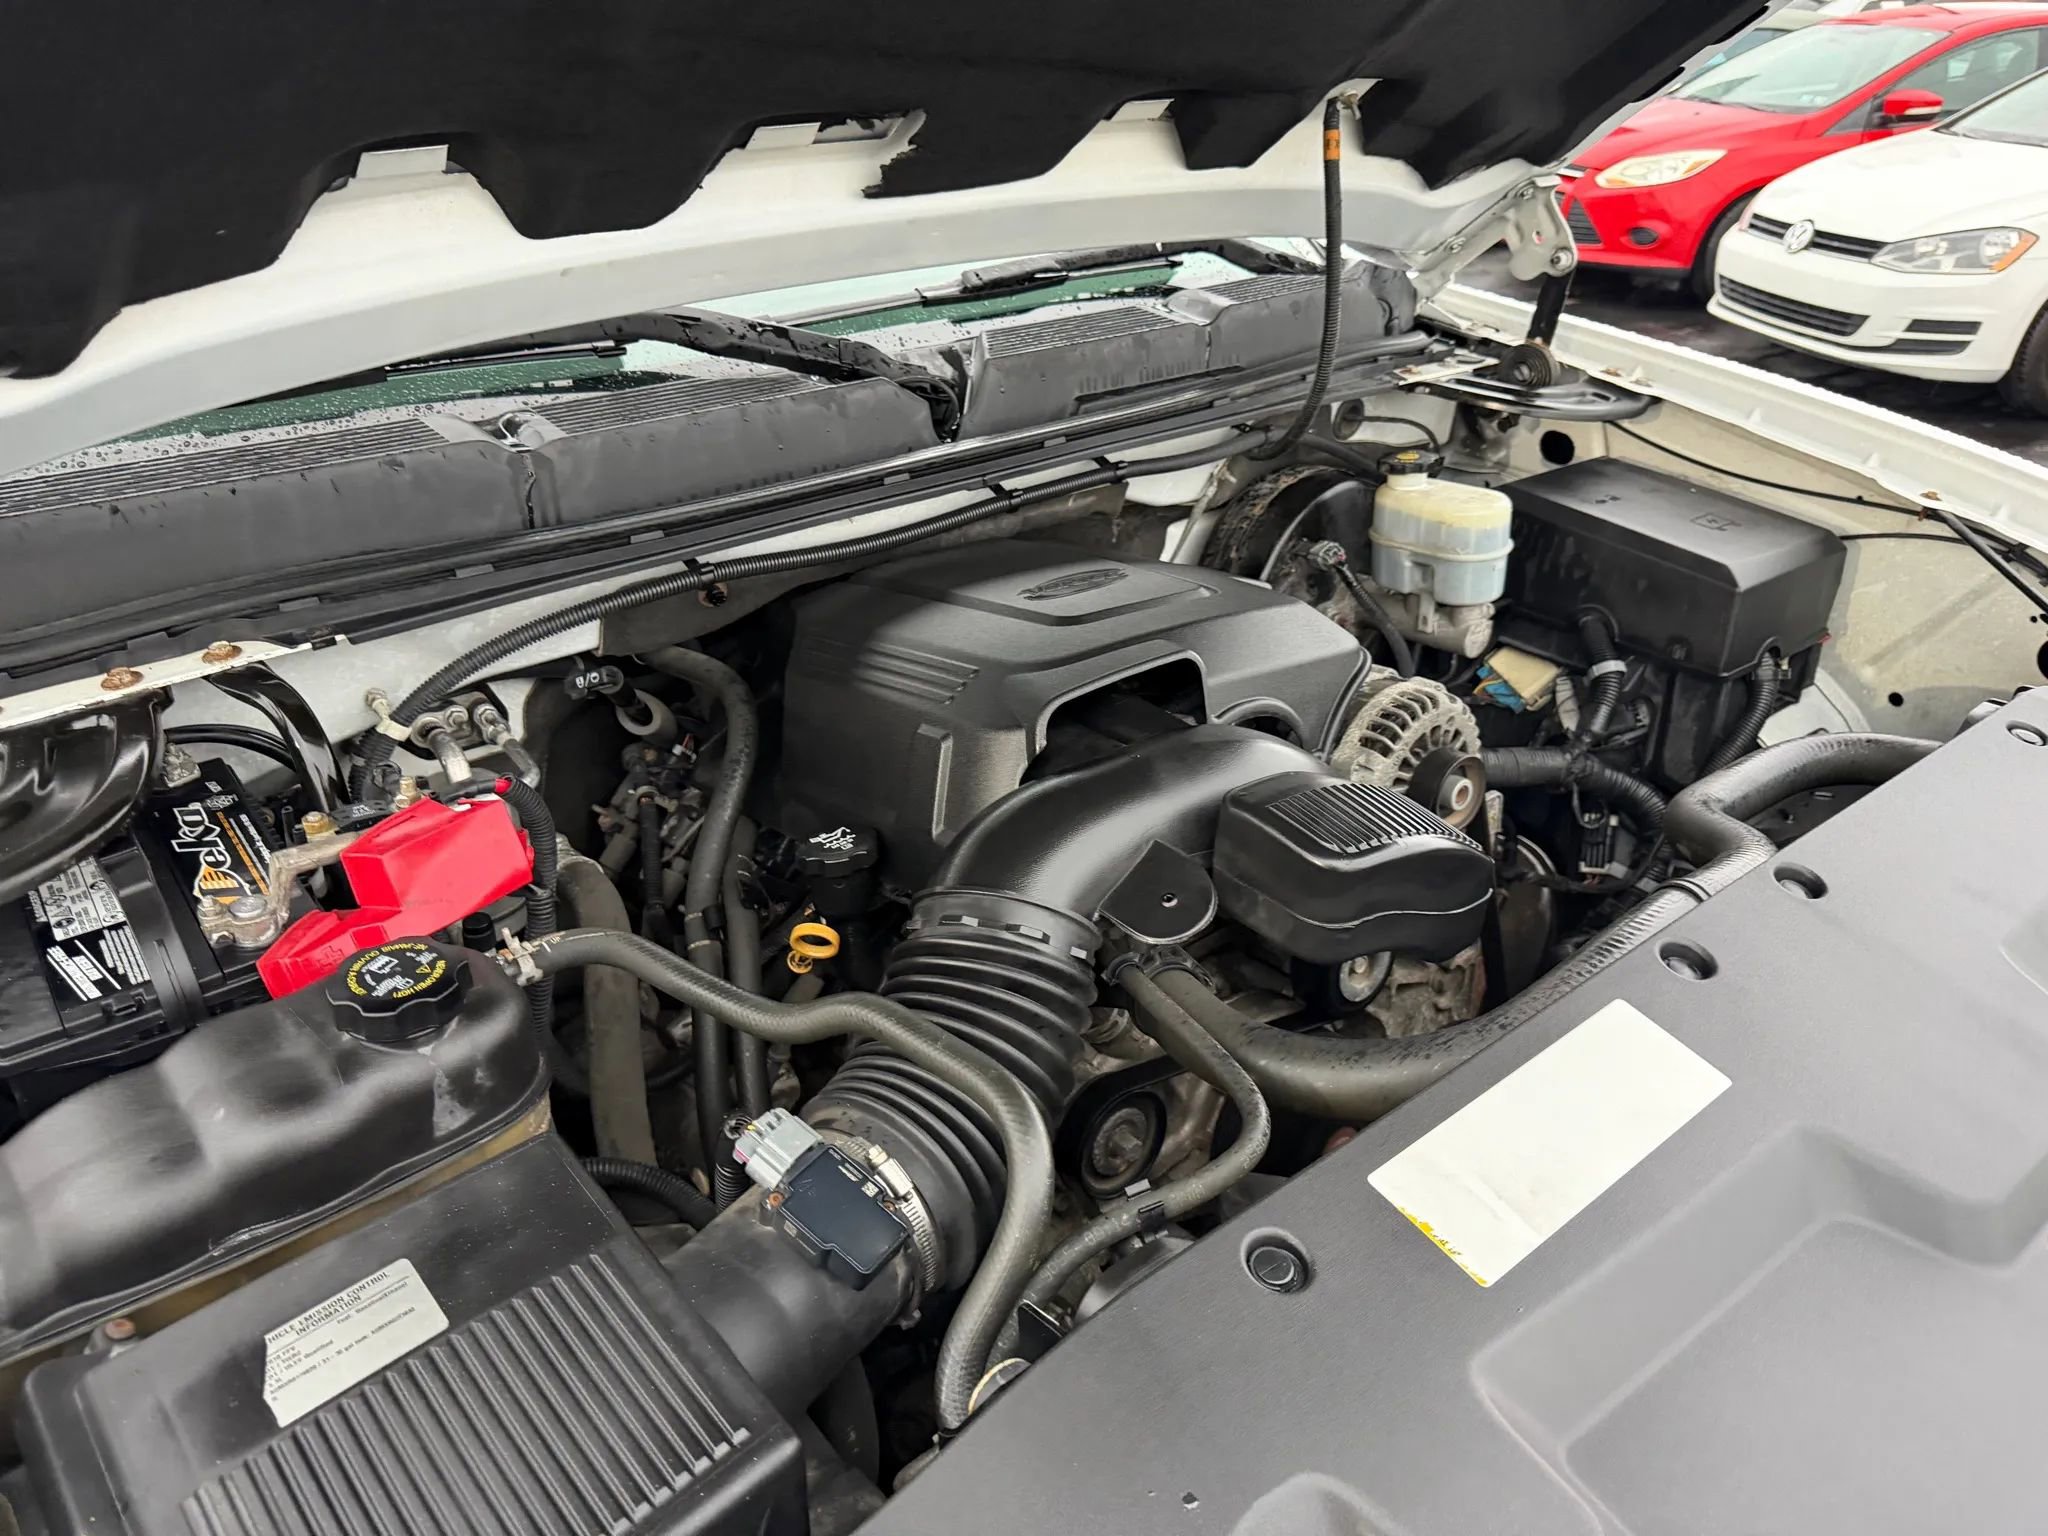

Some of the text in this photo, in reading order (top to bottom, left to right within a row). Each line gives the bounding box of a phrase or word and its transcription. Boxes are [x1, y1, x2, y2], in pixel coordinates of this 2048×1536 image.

[170, 802, 253, 900] Deka
[295, 1295, 362, 1336] INFORMATION
[299, 1296, 345, 1326] EMISSION
[346, 1271, 390, 1300] CONTROL
